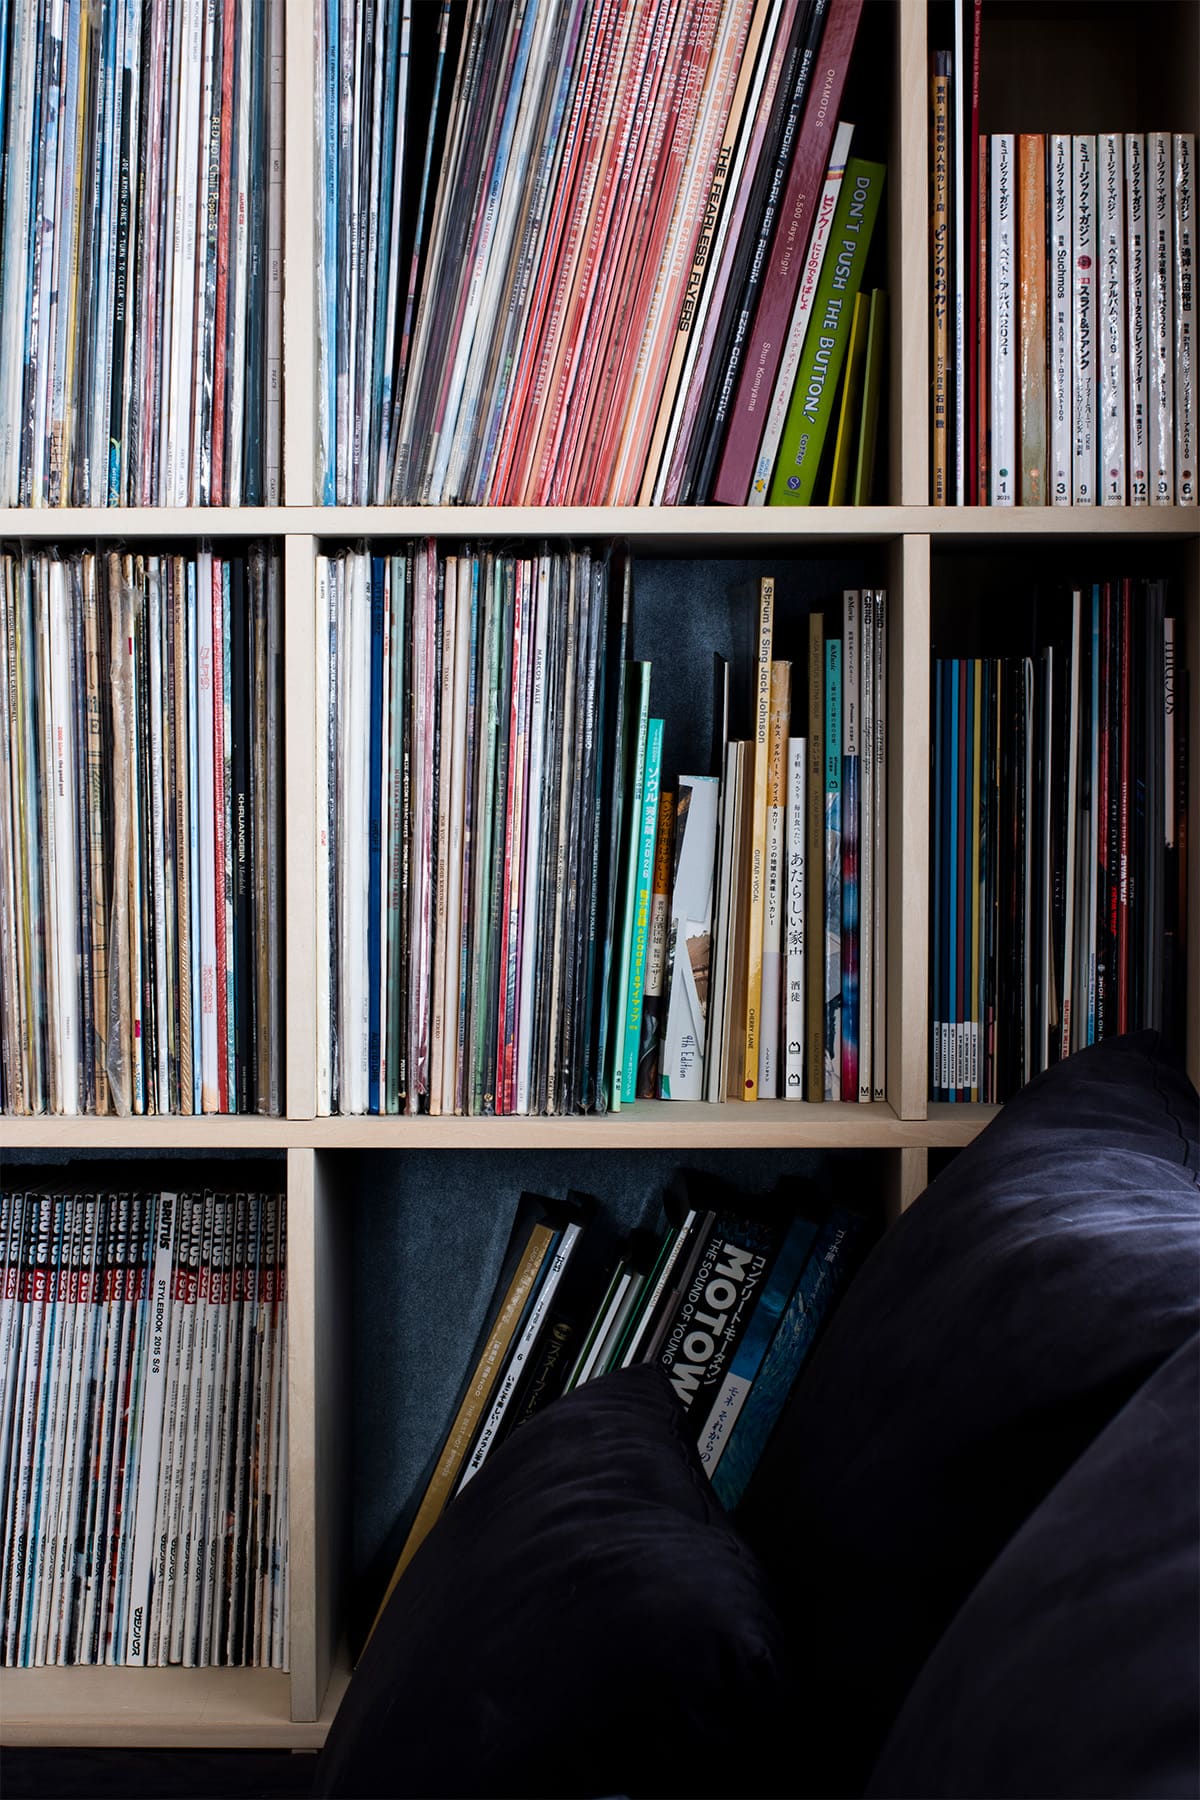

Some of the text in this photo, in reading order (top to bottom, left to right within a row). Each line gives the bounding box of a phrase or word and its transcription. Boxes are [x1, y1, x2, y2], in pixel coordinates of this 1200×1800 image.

[582, 8, 600, 65] VULFPECK
[583, 7, 617, 142] FEARLESS FLYERS III
[630, 37, 648, 97] FEARLESS
[638, 71, 652, 107] THRILL
[643, 5, 677, 125] VULFMON DOT
[671, 58, 690, 113] SCHVITZ
[619, 102, 634, 146] FLYERS
[634, 111, 643, 125] OF
[671, 63, 698, 153] HILL CLIMBER
[815, 69, 836, 128] OKAMOTO'S
[208, 116, 219, 188] RED HOT Chili
[566, 130, 574, 144] OF
[629, 128, 639, 148] THE
[696, 109, 718, 167] MADISON
[622, 152, 634, 180] ARTS
[749, 48, 813, 284] SAMUEL L.RIDDIM DARK SIDE RIDDIM
[999, 139, 1009, 222] ミュージック・マガジン
[1107, 139, 1118, 221] ミュージック・マガジン
[1131, 140, 1142, 222] ミュージック・マガジン
[1156, 139, 1166, 220] ミュージック・マガジン
[1180, 140, 1190, 222] ミュージック・マガジン
[485, 197, 496, 222] MATTO
[786, 193, 806, 243] 5,500 days,
[845, 176, 871, 232] DON'T
[1055, 141, 1066, 299] ミュージック・マガジン Suchmos
[1078, 143, 1090, 248] ミュージック・マガジン
[115, 157, 130, 320] JOE ARMON-JONES TURN TO CLEAR VIEW
[678, 144, 731, 332] THE FEARLESS FLYERS
[832, 240, 857, 291] PUSH
[554, 253, 571, 306] MADISON
[822, 298, 843, 330] THE
[715, 310, 749, 422] EZRA COLLECTIVE
[747, 342, 771, 413] Shun Komiyama
[802, 336, 835, 424] BUTTON!
[998, 481, 1007, 494] 1
[1055, 482, 1066, 494] 3
[1079, 484, 1088, 495] 9
[1110, 482, 1118, 494] 1
[1132, 483, 1146, 495] 12
[1157, 482, 1168, 495] 9
[1182, 482, 1192, 494] 6
[374, 581, 382, 611] LITTLE
[864, 596, 872, 625] GRIND
[876, 600, 884, 629] GRIND
[535, 649, 543, 681] MARCOS
[758, 586, 773, 744] Strum & Sing Jack Johnson
[585, 679, 595, 749] JOHN MAYER TRIO
[237, 793, 247, 863] KHRUANGBIN
[370, 819, 379, 847] DROP
[1120, 852, 1128, 905] STAR WARS
[1096, 974, 1105, 999] HOME
[1096, 1019, 1104, 1032] NO
[679, 1035, 694, 1079] 9th Edition
[10, 1198, 24, 1261] BRUTUS
[35, 1200, 50, 1300] BRUTUS 796
[116, 1200, 128, 1263] BRUTUS
[187, 1203, 202, 1304] BRUTUS 794
[212, 1203, 224, 1267] BRUTUS
[265, 1200, 275, 1265] BRUTUS
[704, 1237, 724, 1262] THE
[151, 1200, 172, 1374] BRUTUS STYLEBOOK 2015 S/S
[688, 1261, 713, 1304] SOUND
[670, 1242, 755, 1414] MOTOW
[680, 1303, 695, 1323] OF
[703, 1255, 767, 1386] コンプリート・モータウン
[661, 1321, 687, 1365] YOUNG
